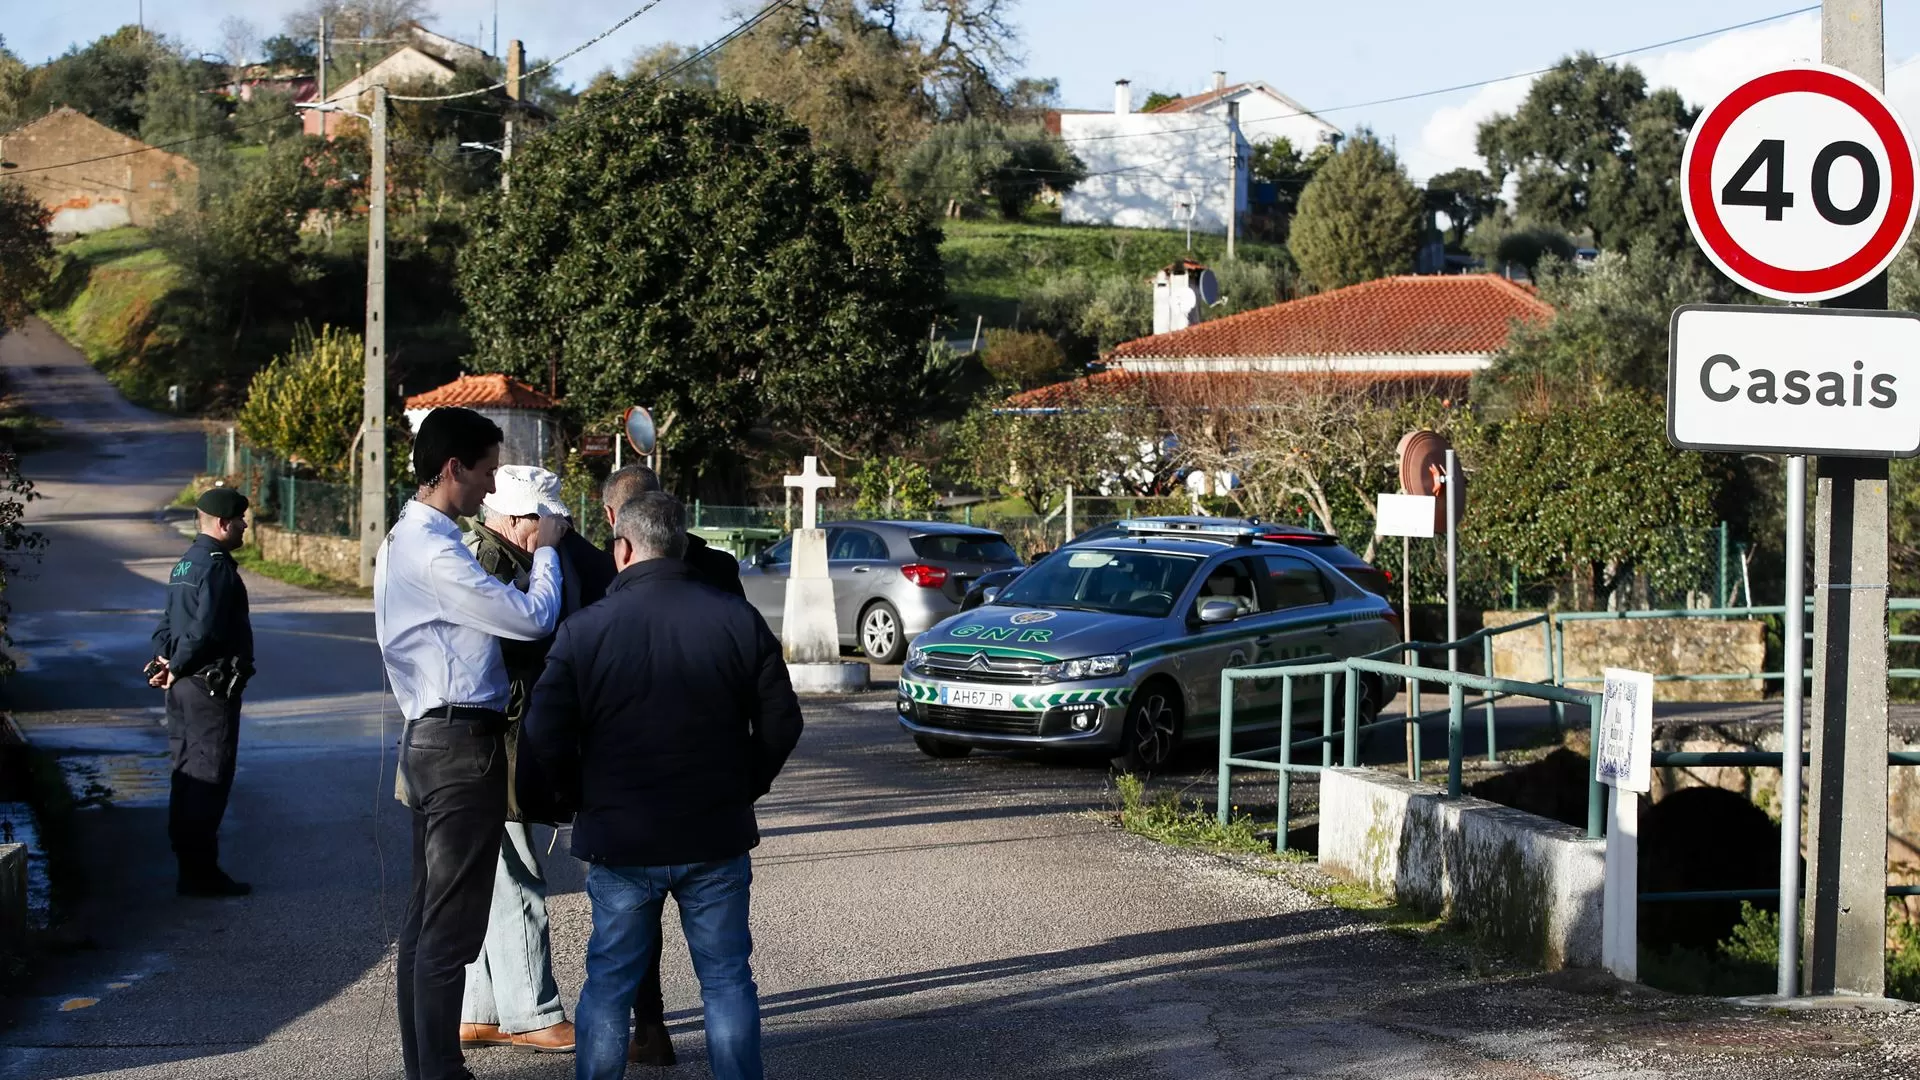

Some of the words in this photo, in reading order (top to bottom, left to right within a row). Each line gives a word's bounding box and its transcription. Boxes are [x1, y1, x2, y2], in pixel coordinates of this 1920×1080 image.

[1721, 139, 1880, 226] 40
[1699, 353, 1898, 409] Casais
[950, 625, 1053, 642] GNR
